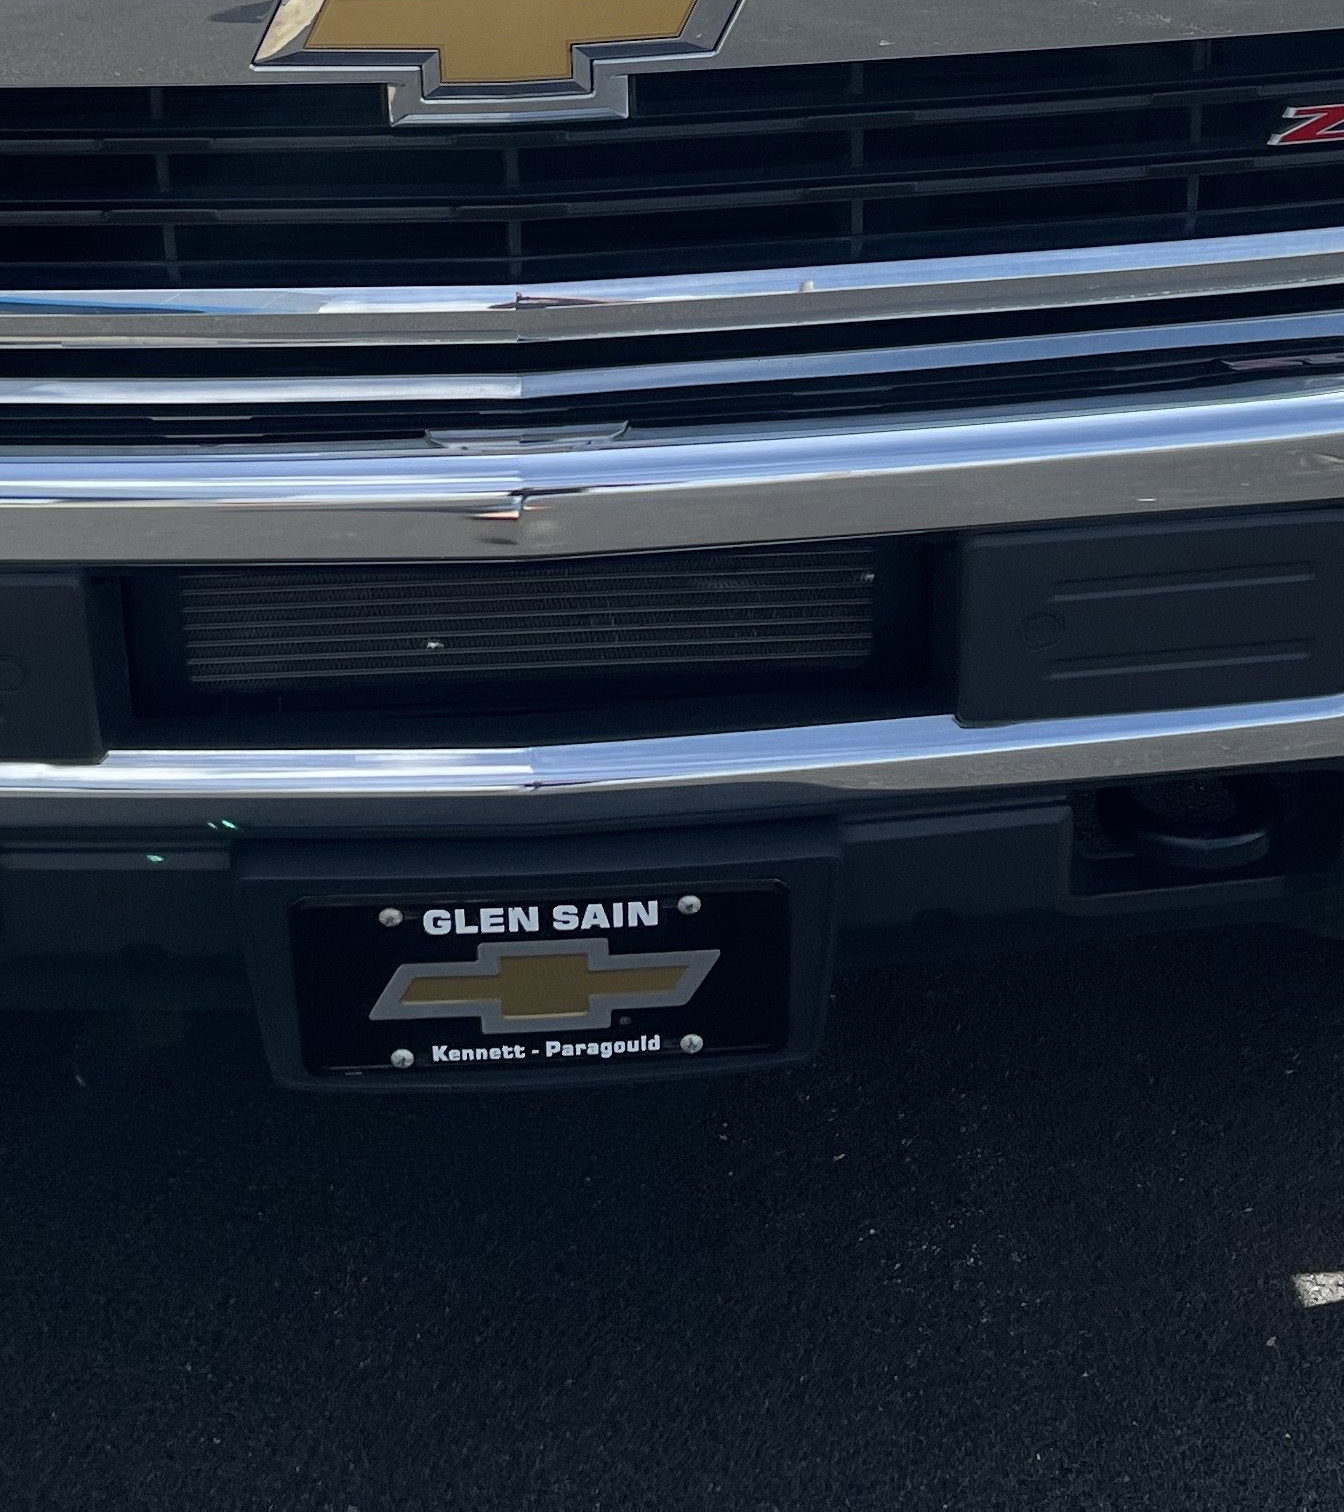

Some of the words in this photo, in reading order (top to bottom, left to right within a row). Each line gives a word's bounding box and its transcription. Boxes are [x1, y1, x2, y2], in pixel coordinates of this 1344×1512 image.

[422, 905, 540, 935] GLEN
[552, 900, 659, 931] SAIN
[432, 1043, 526, 1063] Kennett
[545, 1034, 661, 1059] Paragould
